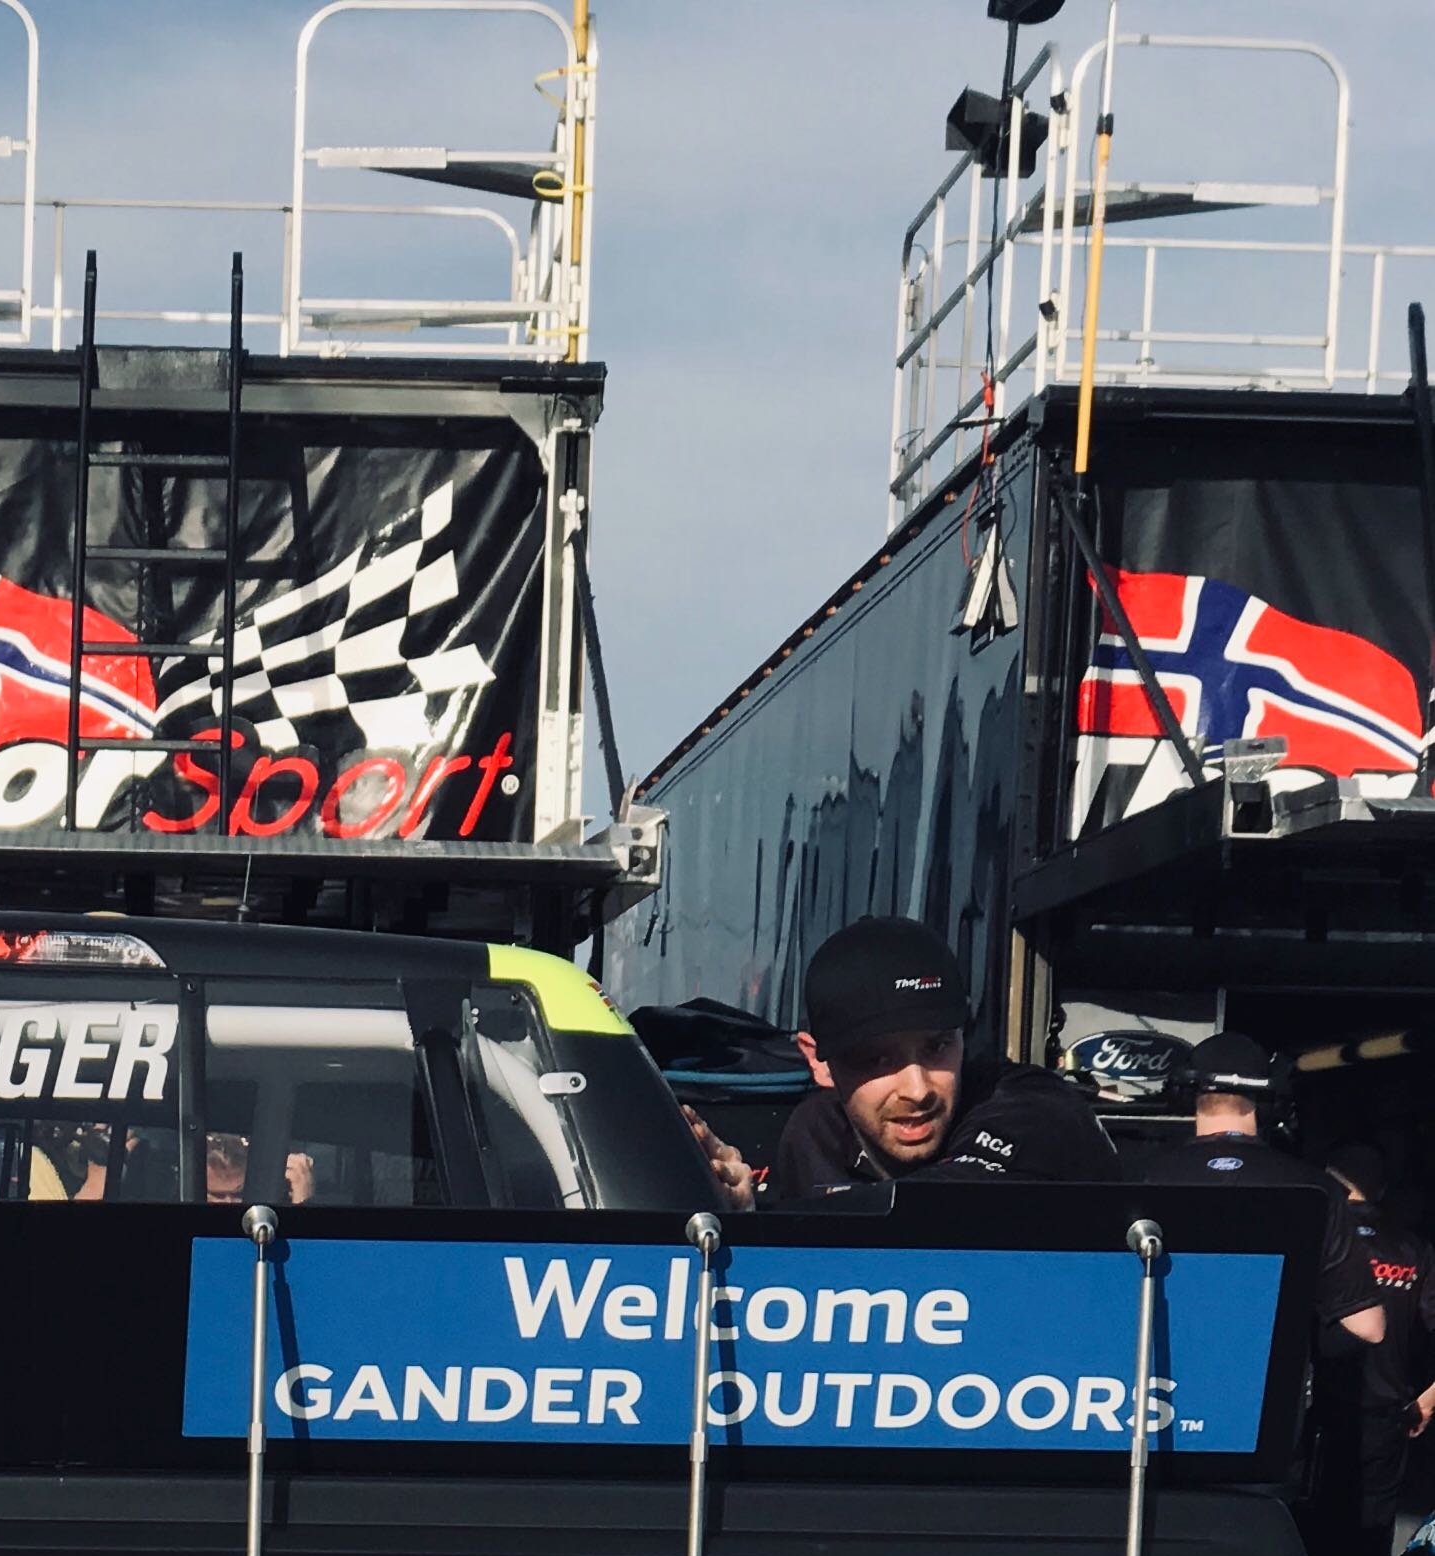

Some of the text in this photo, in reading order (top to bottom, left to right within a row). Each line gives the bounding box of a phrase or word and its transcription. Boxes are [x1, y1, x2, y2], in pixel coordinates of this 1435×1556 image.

[1092, 1037, 1173, 1071] Ford
[504, 1256, 970, 1344] Welcome
[274, 1364, 642, 1424] GANDER
[706, 1370, 1177, 1432] OUTDOORS
